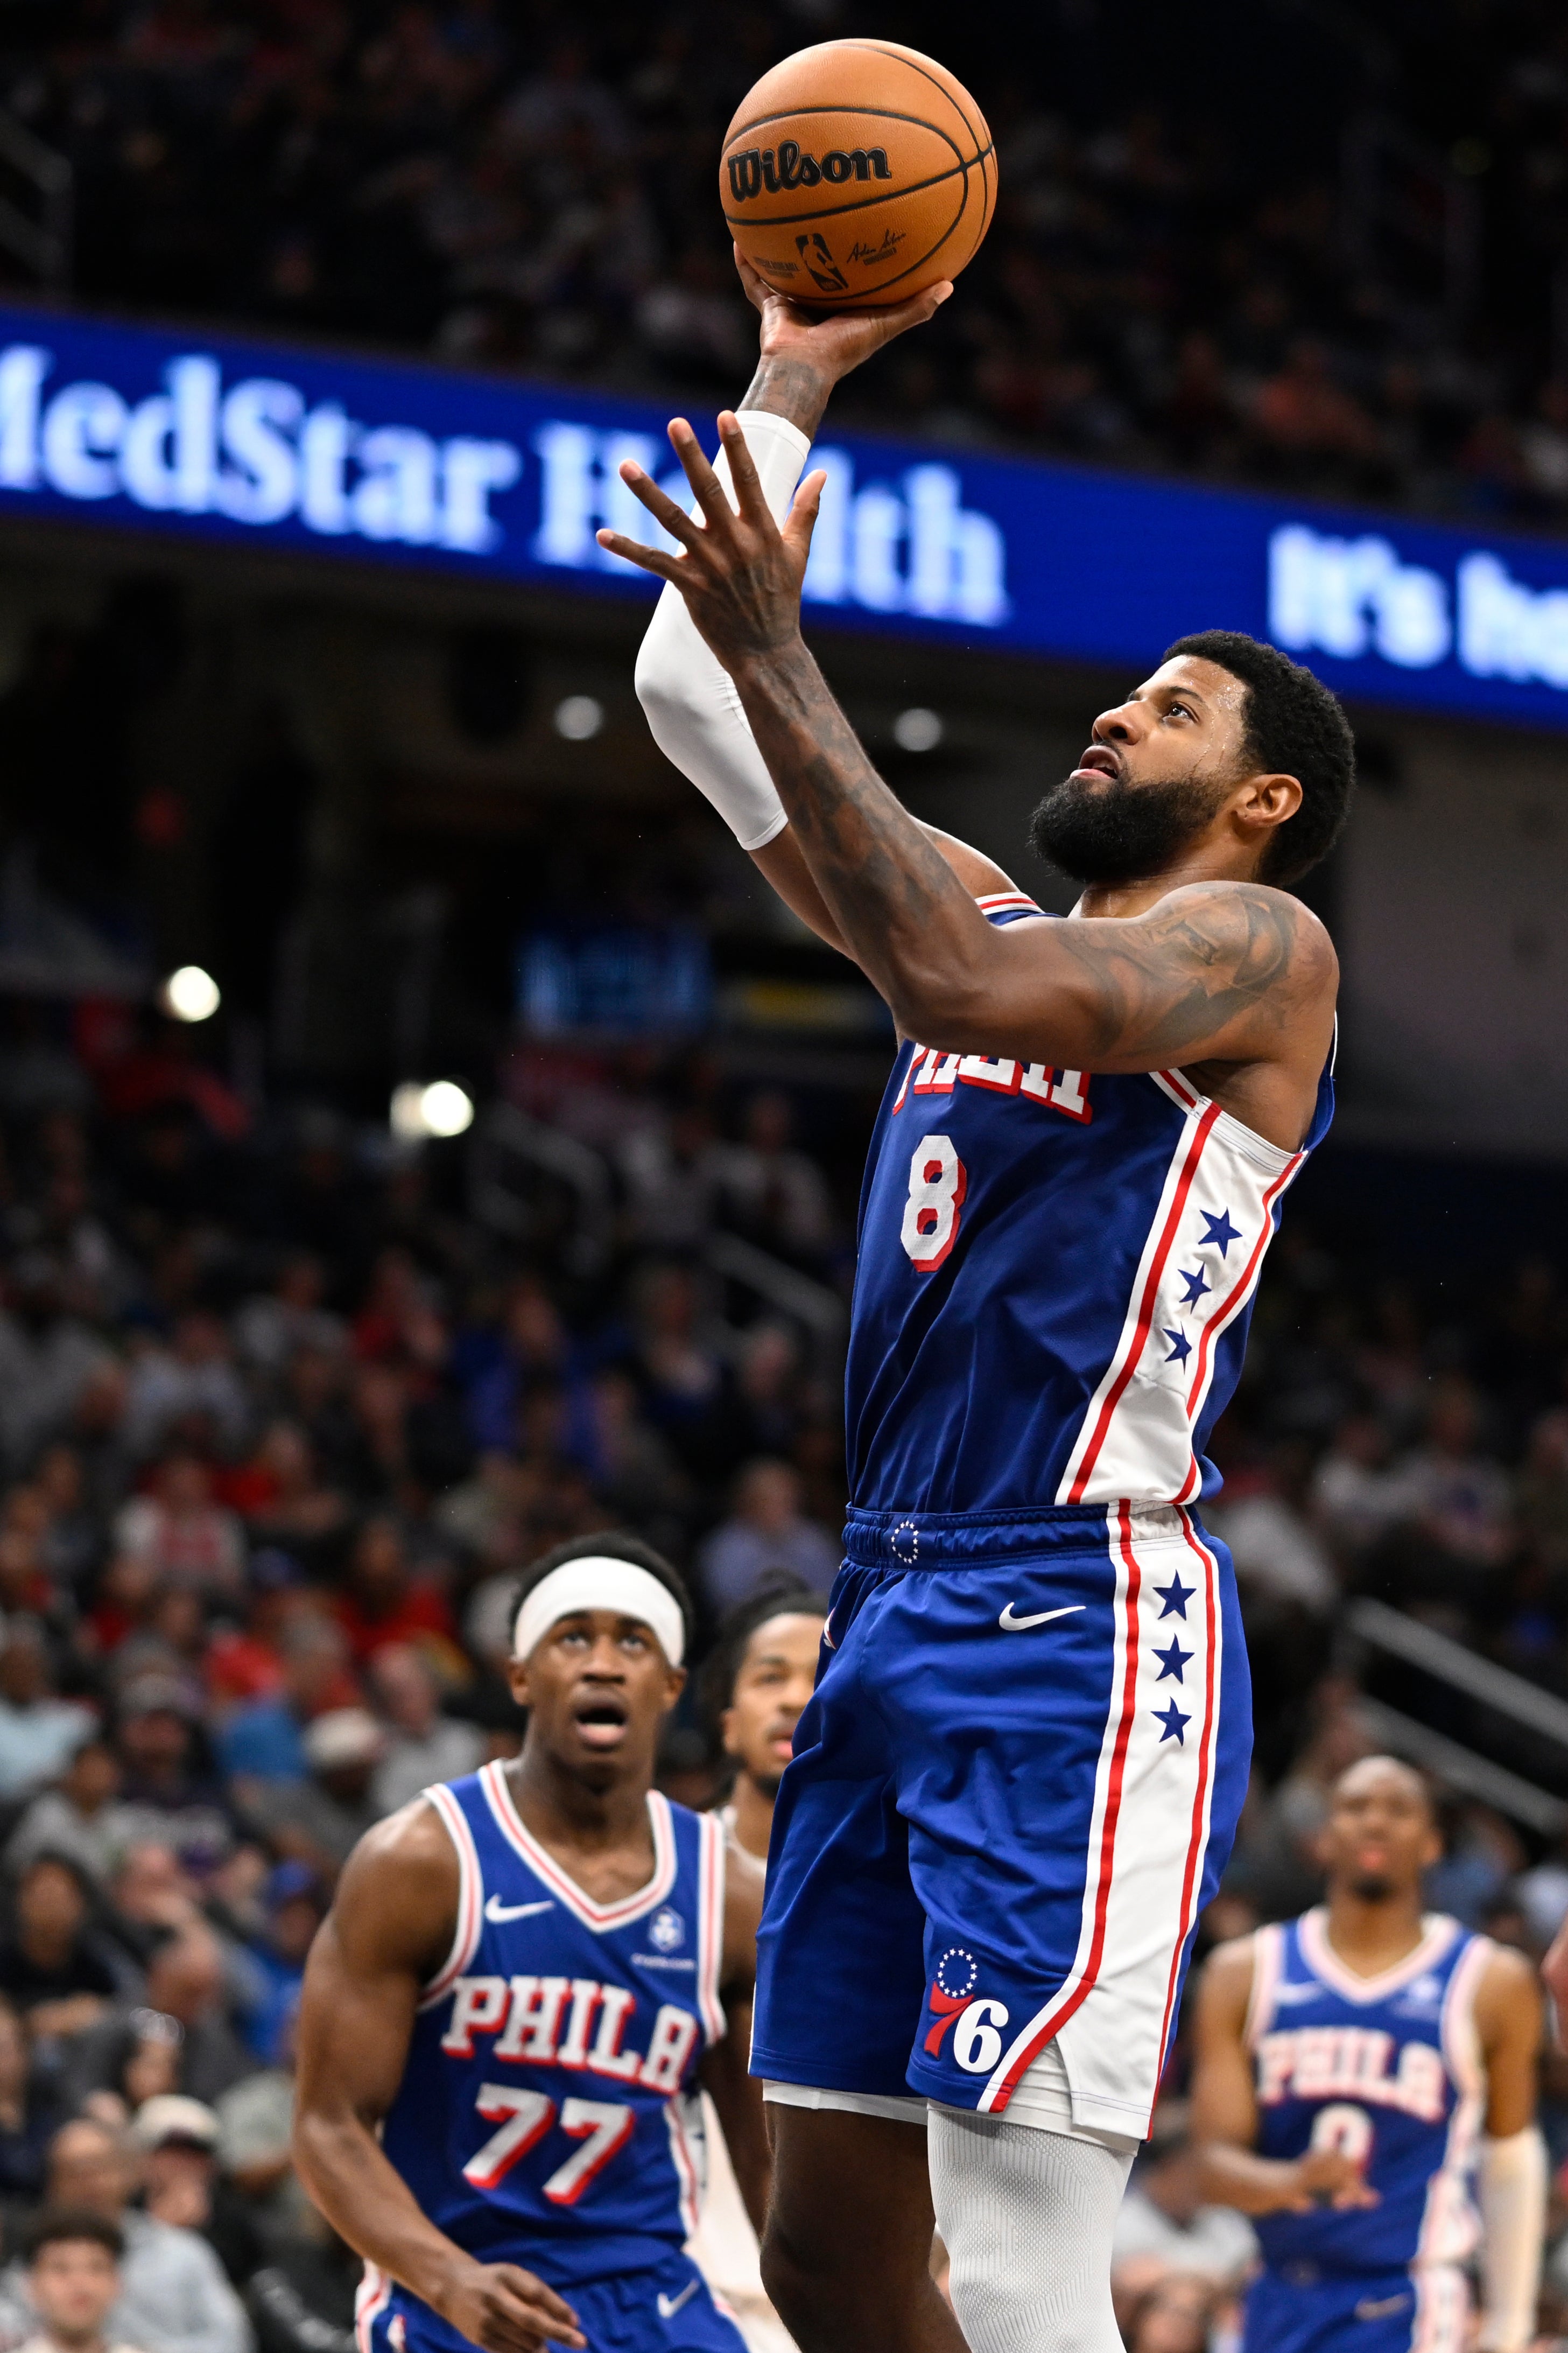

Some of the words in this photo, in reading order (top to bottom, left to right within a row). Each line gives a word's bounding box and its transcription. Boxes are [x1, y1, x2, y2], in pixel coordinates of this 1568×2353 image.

[727, 140, 892, 202] Wilson
[536, 421, 1009, 627] Hlth
[901, 1135, 967, 1273] 8
[441, 1976, 698, 2096] PHILA
[924, 1981, 1009, 2073] 76
[1257, 2028, 1445, 2120] PHILA
[463, 2083, 636, 2205] 77
